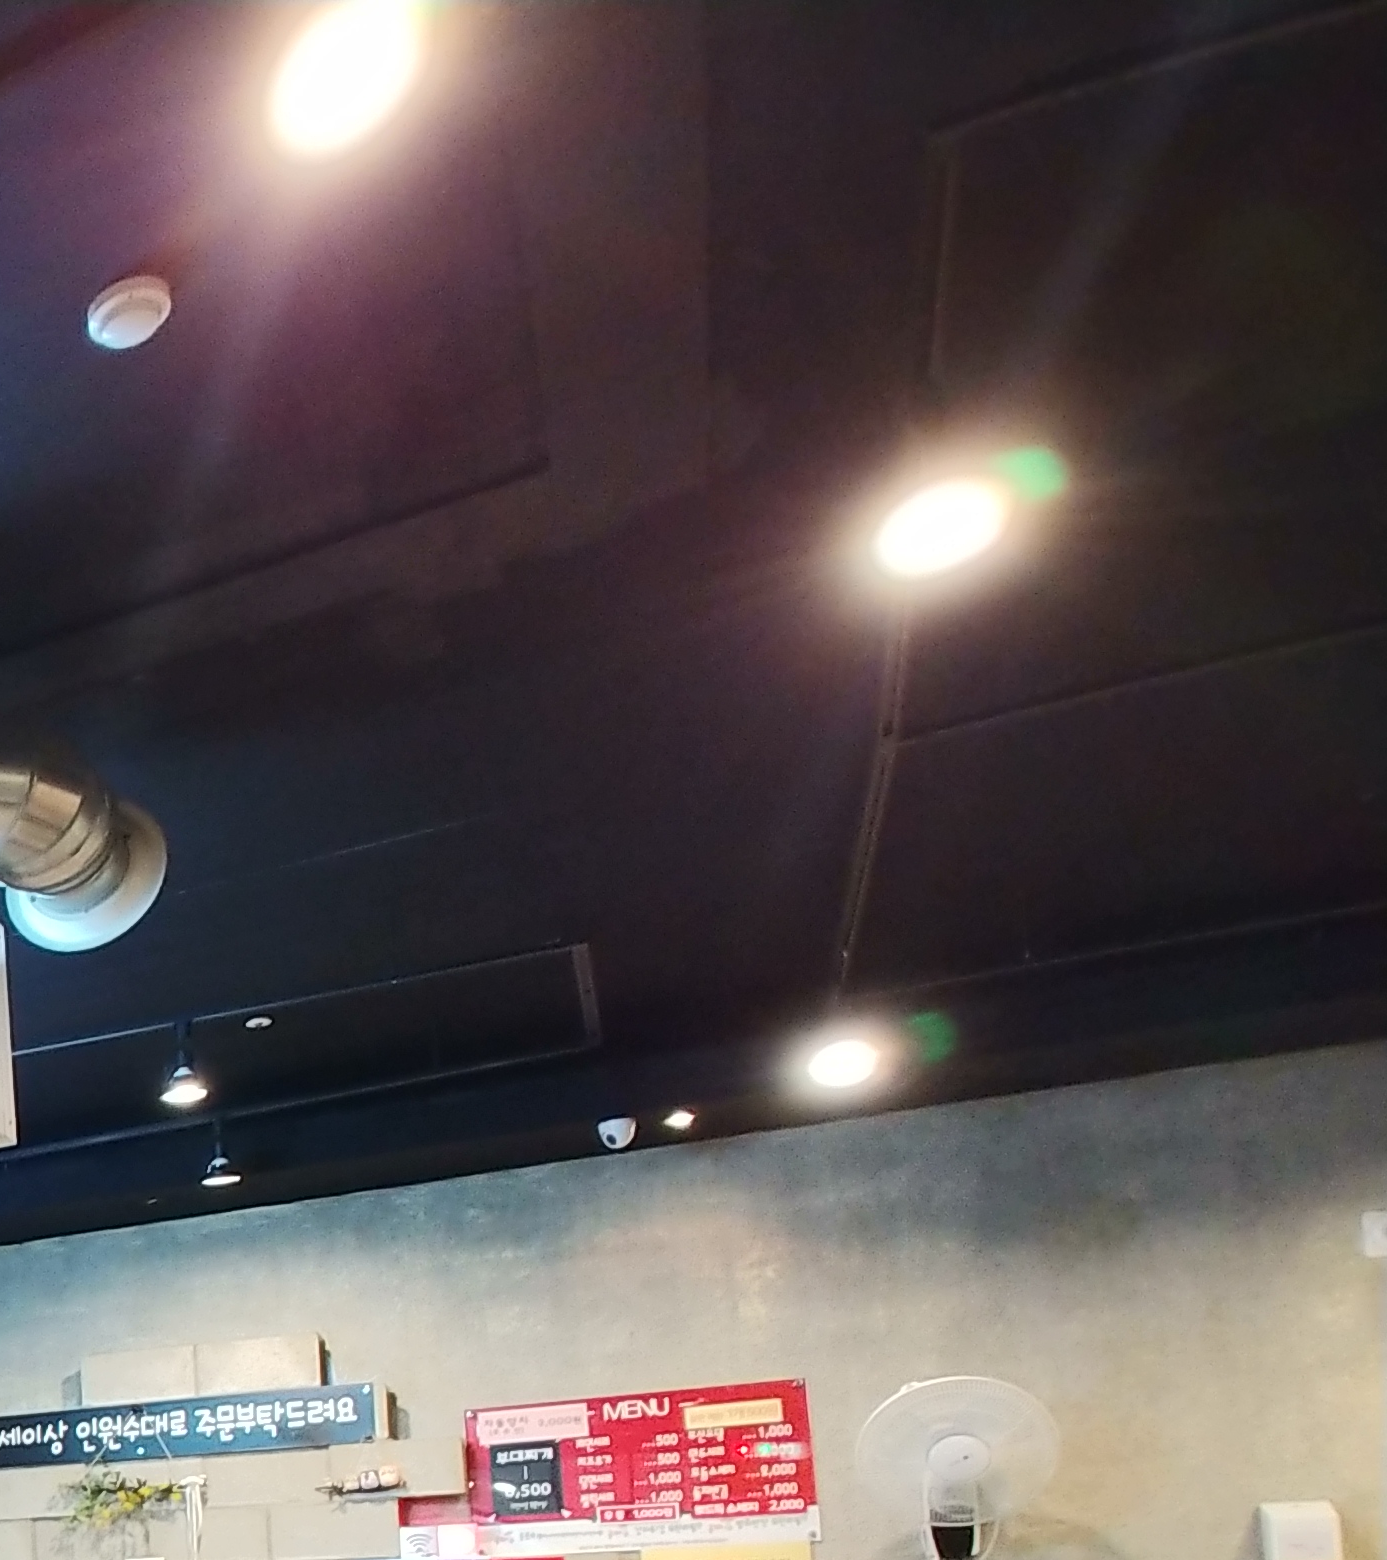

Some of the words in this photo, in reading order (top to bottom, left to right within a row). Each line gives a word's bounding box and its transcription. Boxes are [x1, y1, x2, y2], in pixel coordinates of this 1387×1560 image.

[602, 1396, 671, 1421] MENU
[75, 1408, 189, 1454] 인원수대로
[194, 1396, 359, 1442] 주문부탁드려요
[757, 1423, 794, 1438] 1,000
[655, 1432, 679, 1447] 500
[657, 1451, 681, 1466] 500
[648, 1470, 682, 1486] 1,000
[650, 1489, 684, 1505] 1,000
[763, 1481, 800, 1497] 1,000
[768, 1498, 805, 1512] 2,000
